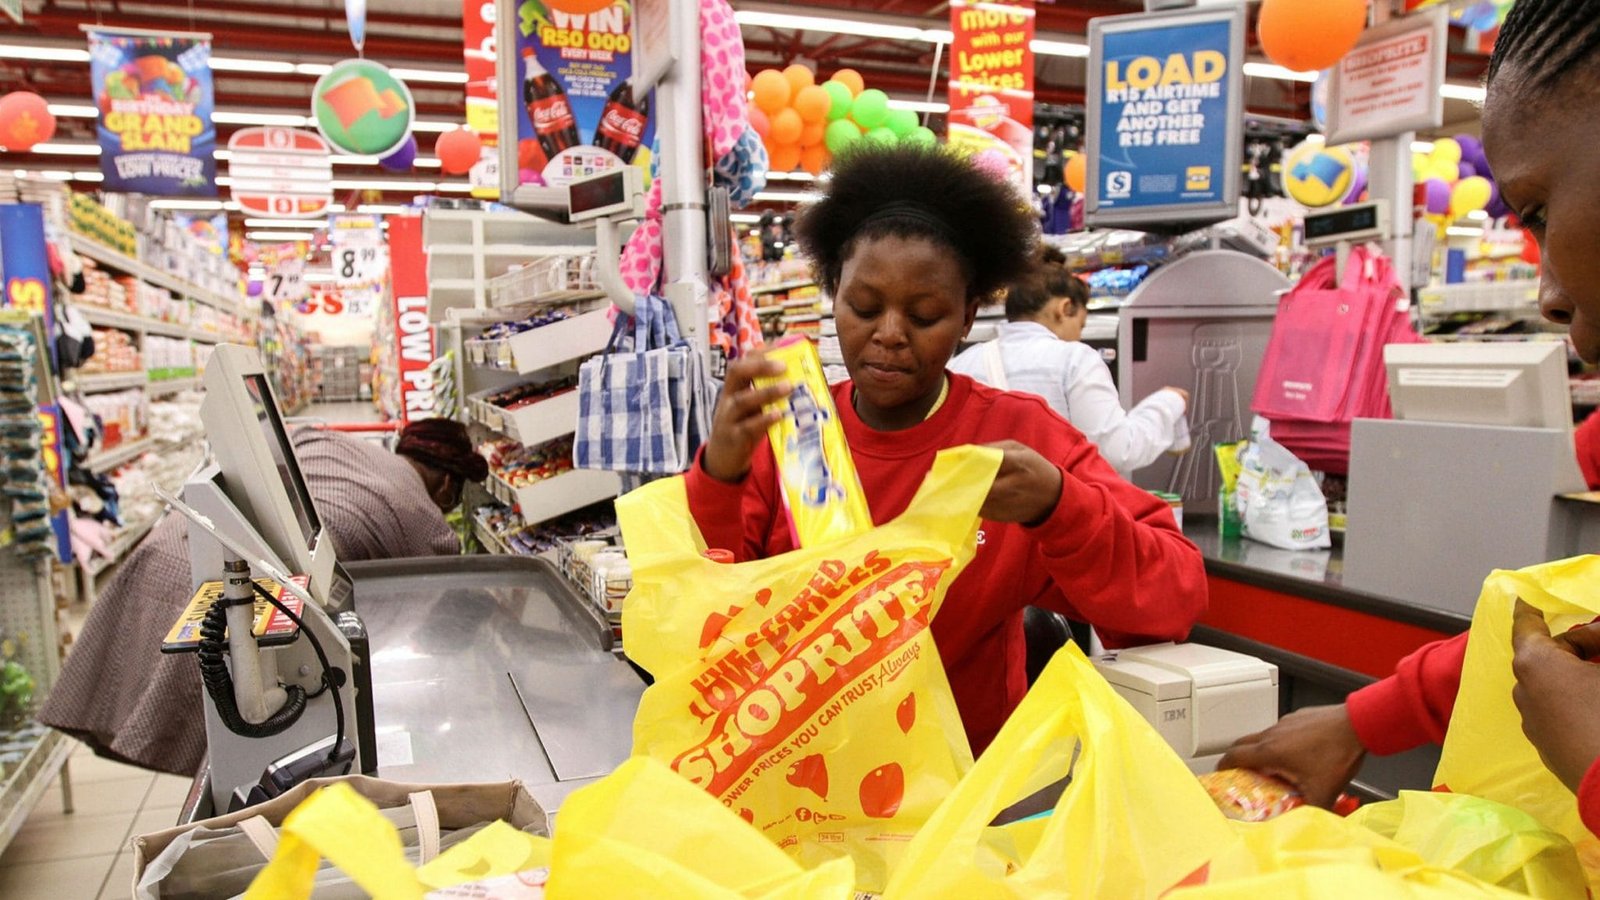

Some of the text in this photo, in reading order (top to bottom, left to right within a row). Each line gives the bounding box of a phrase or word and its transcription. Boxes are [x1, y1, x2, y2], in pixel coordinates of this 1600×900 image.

[552, 6, 624, 34] WIN
[542, 26, 630, 53] R50 000
[970, 31, 1025, 48] with our
[561, 47, 587, 59] EVERY
[959, 48, 1024, 73] Lower
[1106, 50, 1227, 91] LOAD
[959, 70, 1025, 97] Prices
[1106, 82, 1220, 104] R15 AIRTIME
[1121, 99, 1202, 117] AND GET
[105, 112, 203, 137] GRAND
[1116, 113, 1205, 132] ANOTHER
[121, 131, 190, 154] SLAM
[1119, 128, 1200, 147] R15 FREE
[398, 297, 433, 361] LOW
[678, 569, 924, 790] SHOPRITE
[721, 640, 921, 808] OWER PRICES YOU CAN TRUST Always
[1163, 708, 1187, 722] IBM
